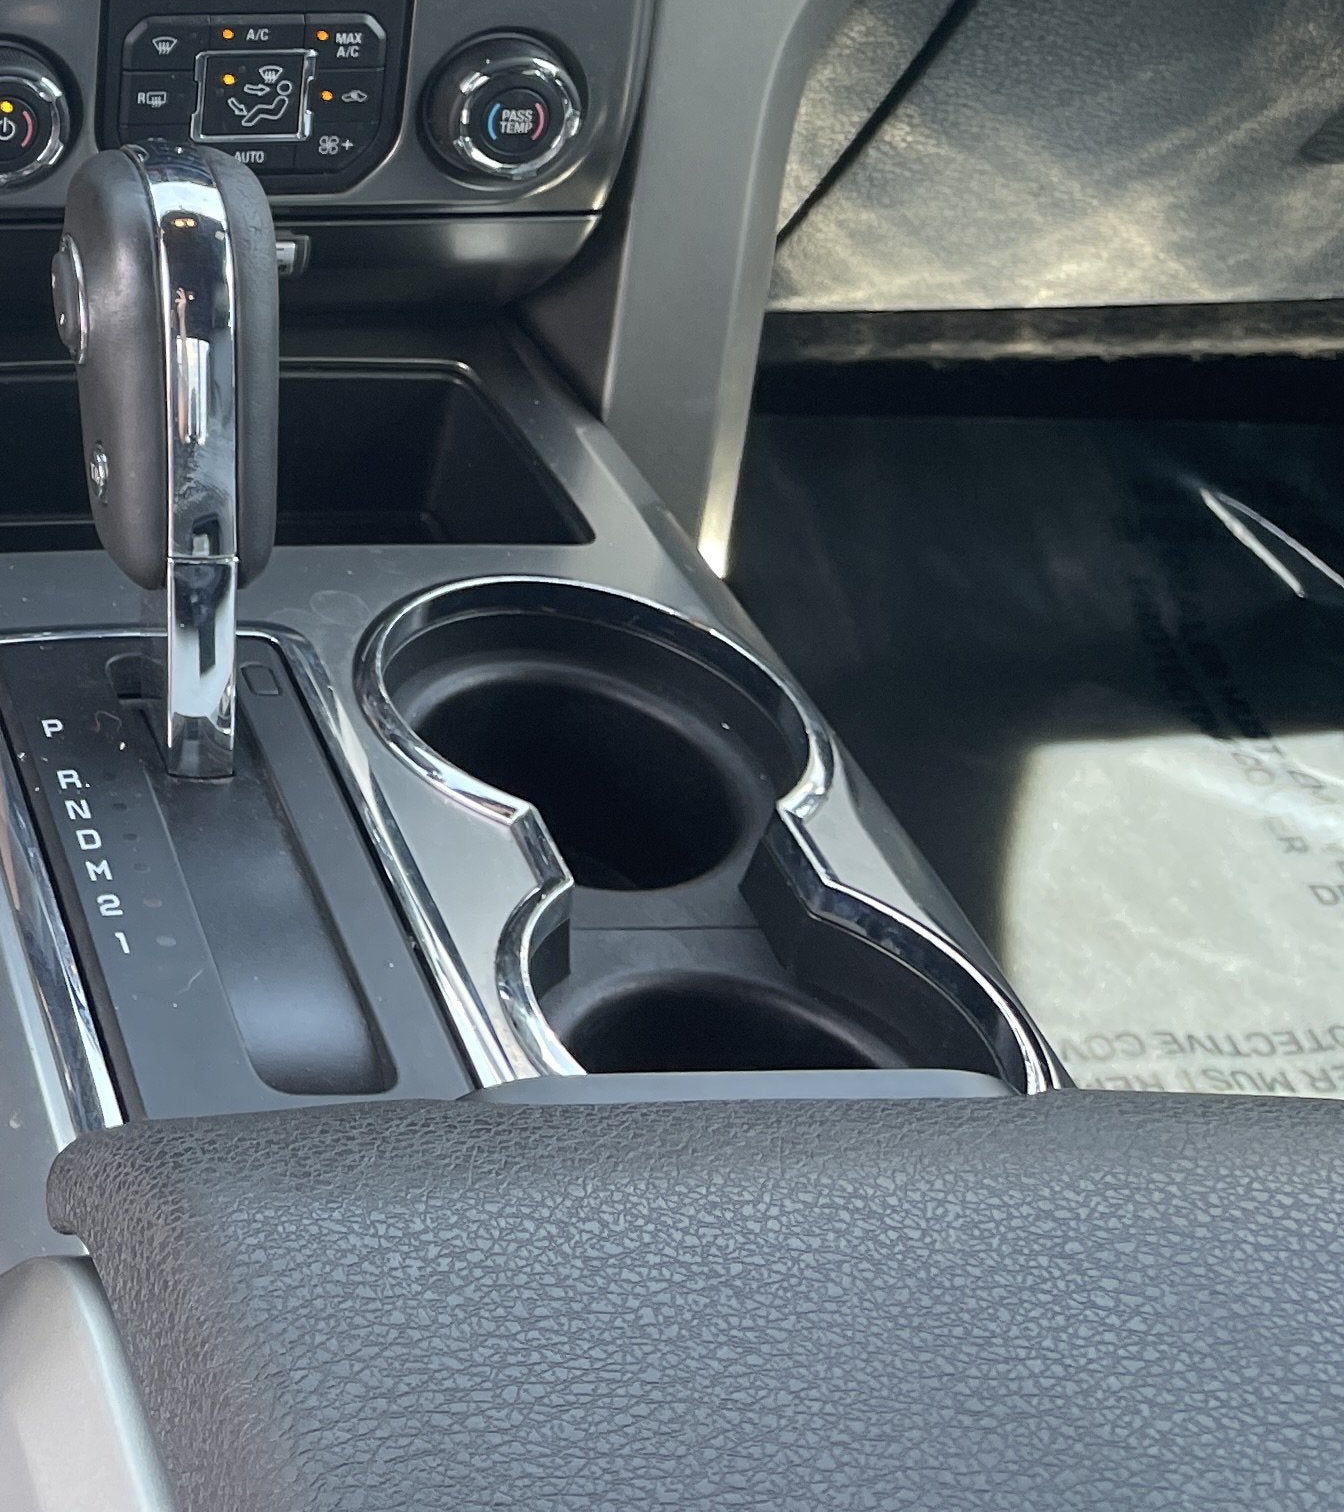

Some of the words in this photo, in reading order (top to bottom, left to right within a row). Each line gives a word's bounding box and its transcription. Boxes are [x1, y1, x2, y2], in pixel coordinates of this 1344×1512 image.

[245, 28, 269, 41] A/C
[335, 32, 362, 44] MAX
[336, 45, 360, 58] A/C
[501, 110, 533, 124] PASS
[499, 121, 533, 135] TEMP
[234, 151, 265, 163] AUTO
[40, 718, 64, 738] P
[56, 769, 83, 790] R
[64, 799, 93, 820] N
[75, 829, 103, 851] D
[85, 859, 113, 882] M
[96, 893, 124, 917] 2
[114, 931, 131, 955] 1
